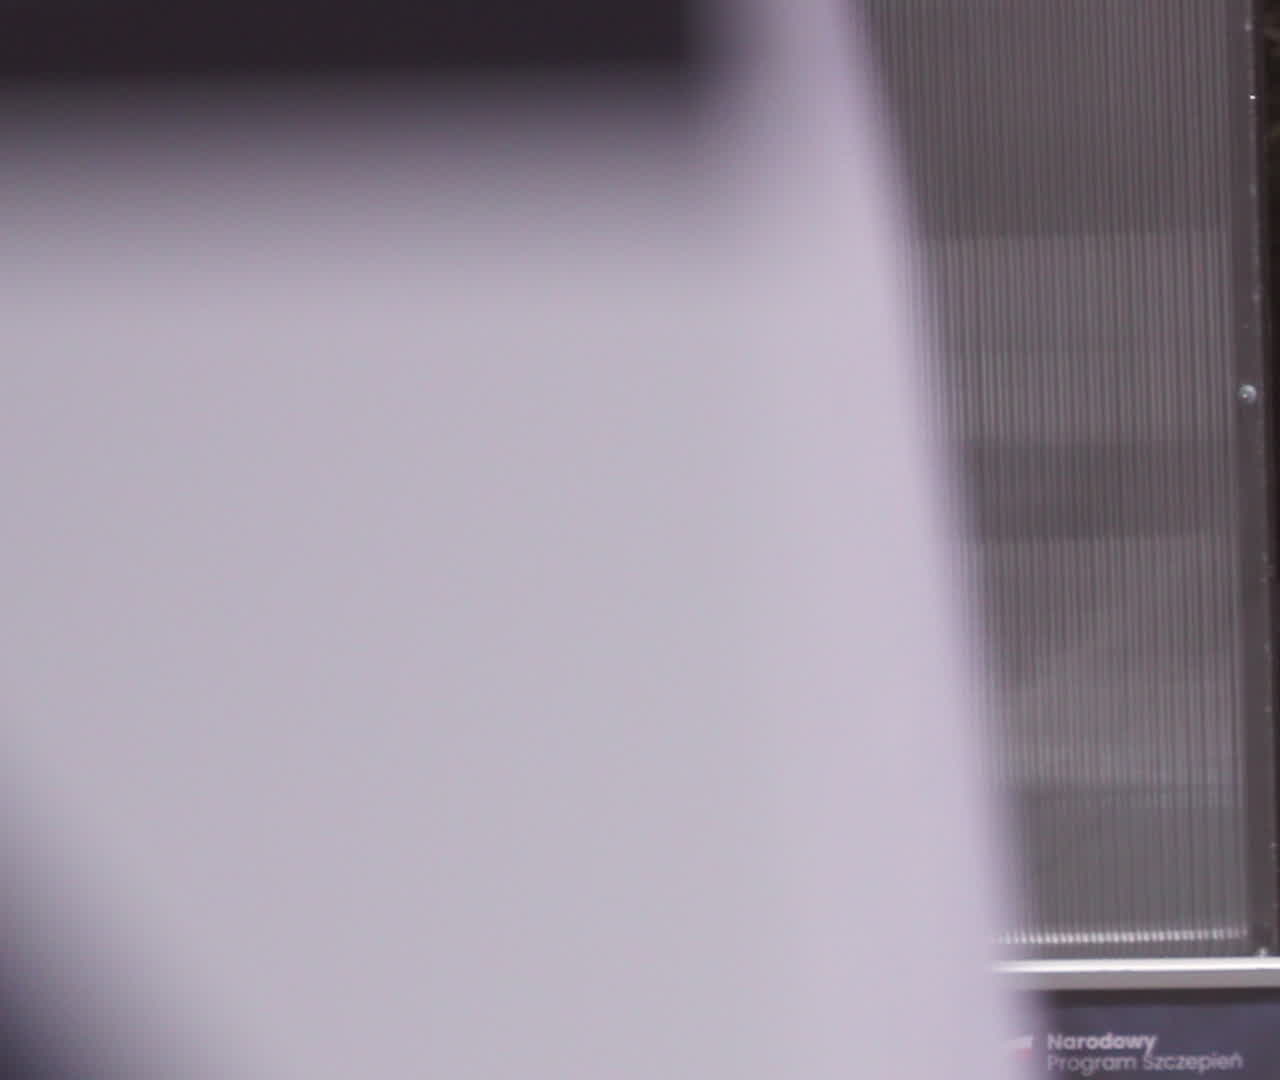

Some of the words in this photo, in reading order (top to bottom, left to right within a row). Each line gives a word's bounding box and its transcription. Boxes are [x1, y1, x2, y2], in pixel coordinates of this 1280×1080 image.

[1047, 1032, 1157, 1057] Narodowy
[1047, 1054, 1137, 1077] Program
[1143, 1051, 1244, 1074] Szczepień
